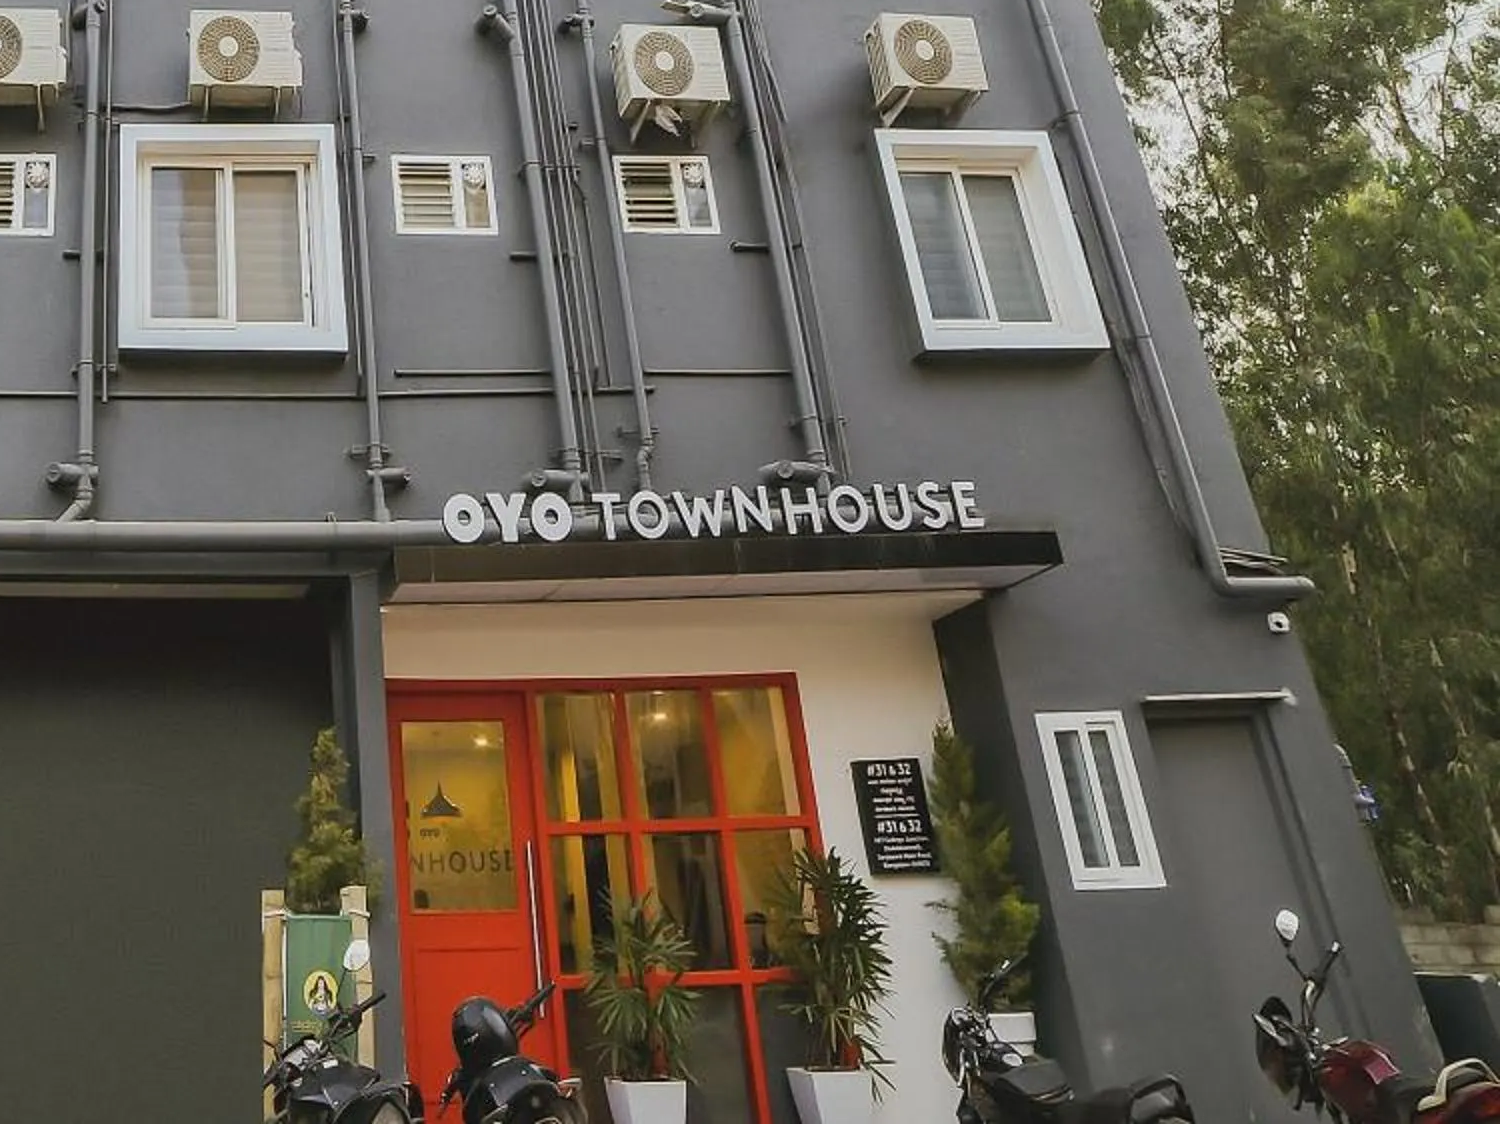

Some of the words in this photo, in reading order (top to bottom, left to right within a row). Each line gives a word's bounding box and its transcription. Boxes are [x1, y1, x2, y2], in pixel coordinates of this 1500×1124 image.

[442, 492, 573, 544] OYO
[592, 480, 986, 541] TOWNHOUSE
[897, 763, 911, 775] 32
[907, 819, 922, 832] 32
